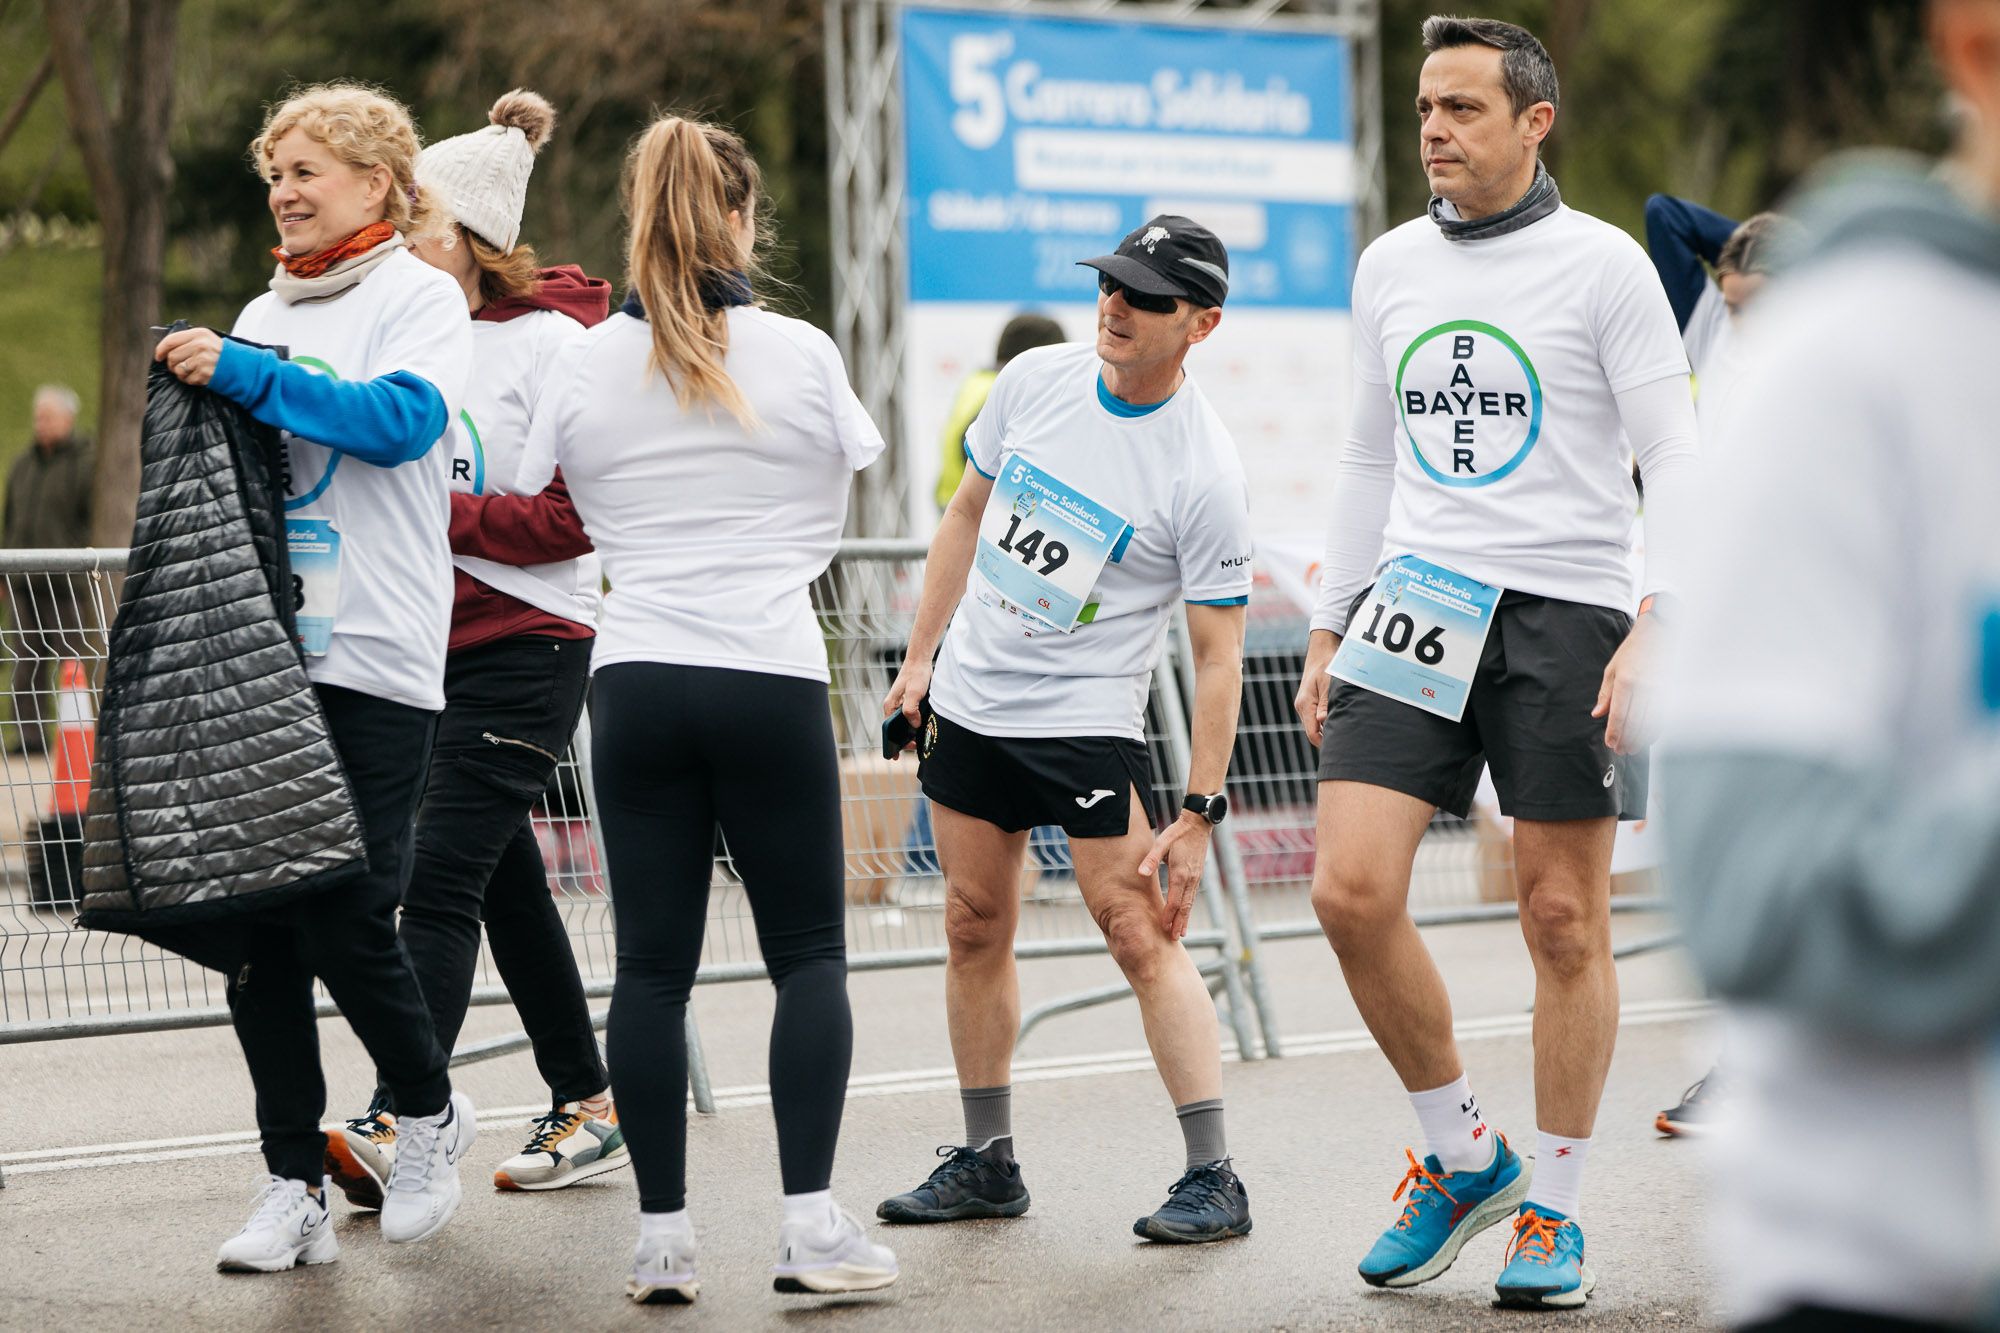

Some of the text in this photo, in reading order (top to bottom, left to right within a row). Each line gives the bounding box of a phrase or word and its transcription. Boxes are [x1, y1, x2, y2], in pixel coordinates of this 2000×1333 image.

[1006, 60, 1152, 125] Carrera
[1405, 390, 1528, 417] BAYER
[1449, 335, 1477, 474] BAYER
[1024, 475, 1060, 502] Carrera
[1060, 495, 1100, 526] Solidaria
[998, 513, 1069, 577] 149
[1037, 598, 1050, 610] CSL
[1424, 573, 1472, 601] Solidaria
[1361, 603, 1446, 666] 106
[1421, 687, 1436, 699] CSL
